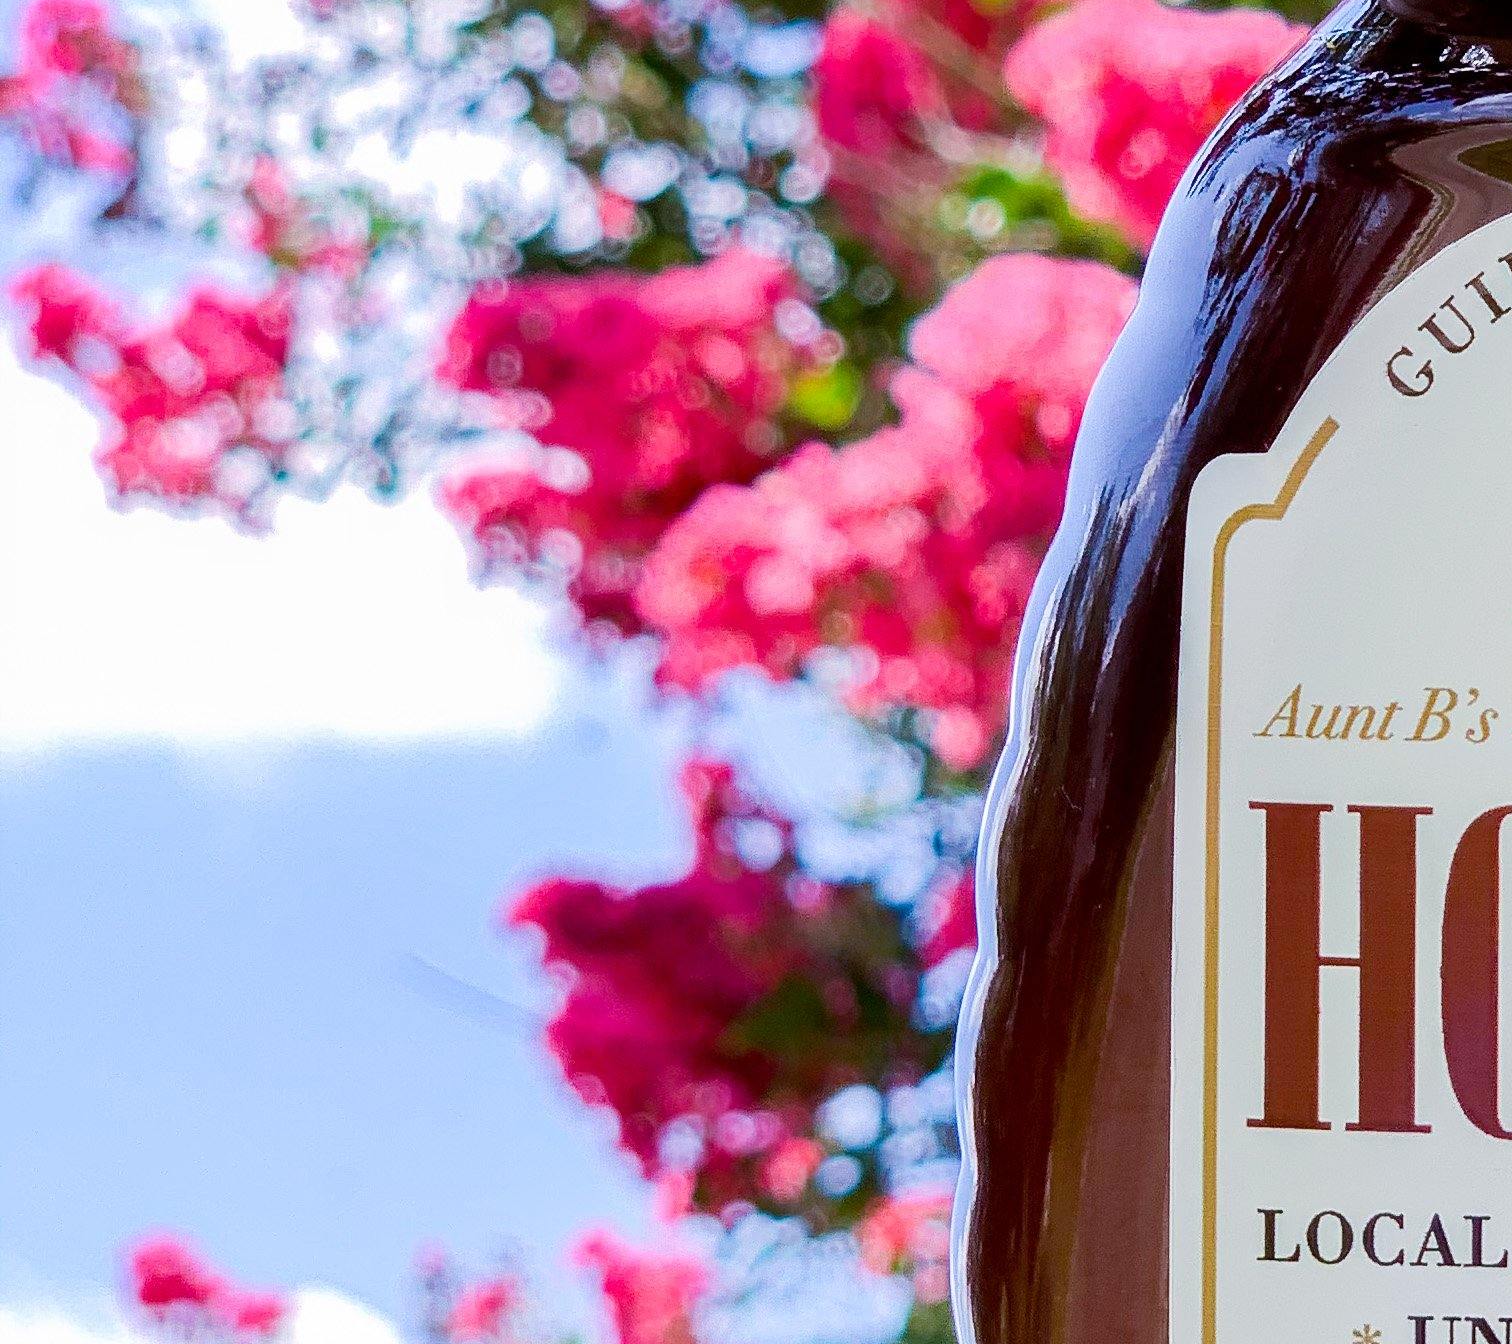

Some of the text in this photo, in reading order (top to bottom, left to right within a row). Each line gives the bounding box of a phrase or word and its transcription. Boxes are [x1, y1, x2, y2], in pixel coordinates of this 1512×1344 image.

[1252, 683, 1499, 744] Aunt B's
[1256, 1208, 1509, 1269] LOCAL
